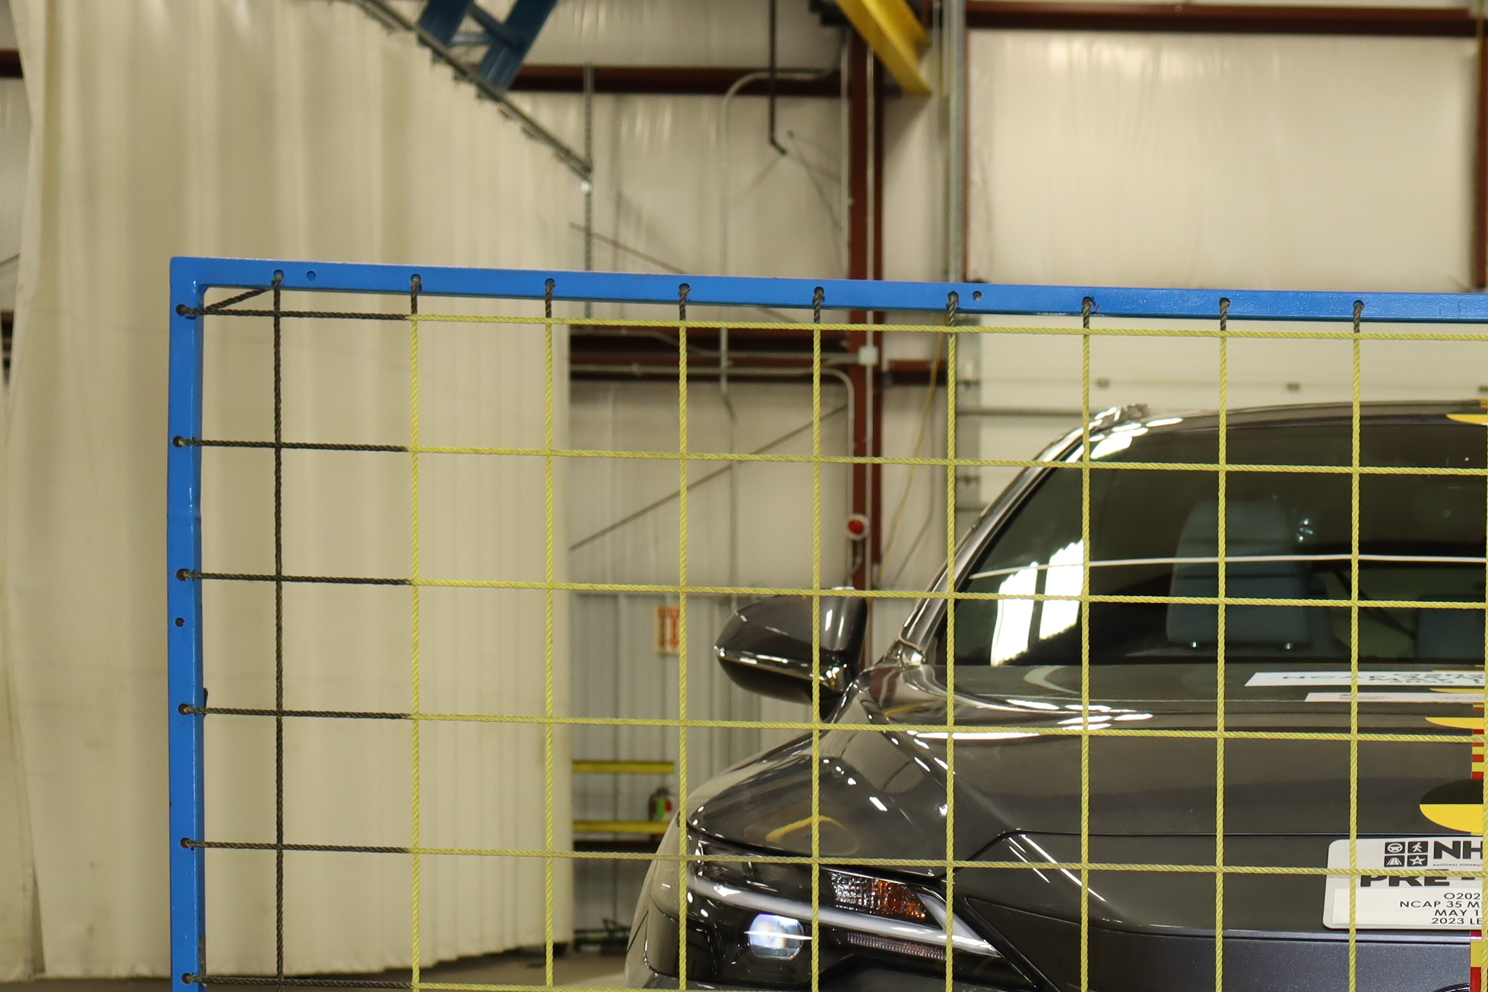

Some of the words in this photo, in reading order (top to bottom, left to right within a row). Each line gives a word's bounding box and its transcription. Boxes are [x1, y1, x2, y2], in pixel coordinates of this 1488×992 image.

[1399, 900, 1441, 908] NCAP
[1446, 900, 1462, 908] 35
[1434, 909, 1467, 917] MAY
[1431, 917, 1465, 925] 2023
